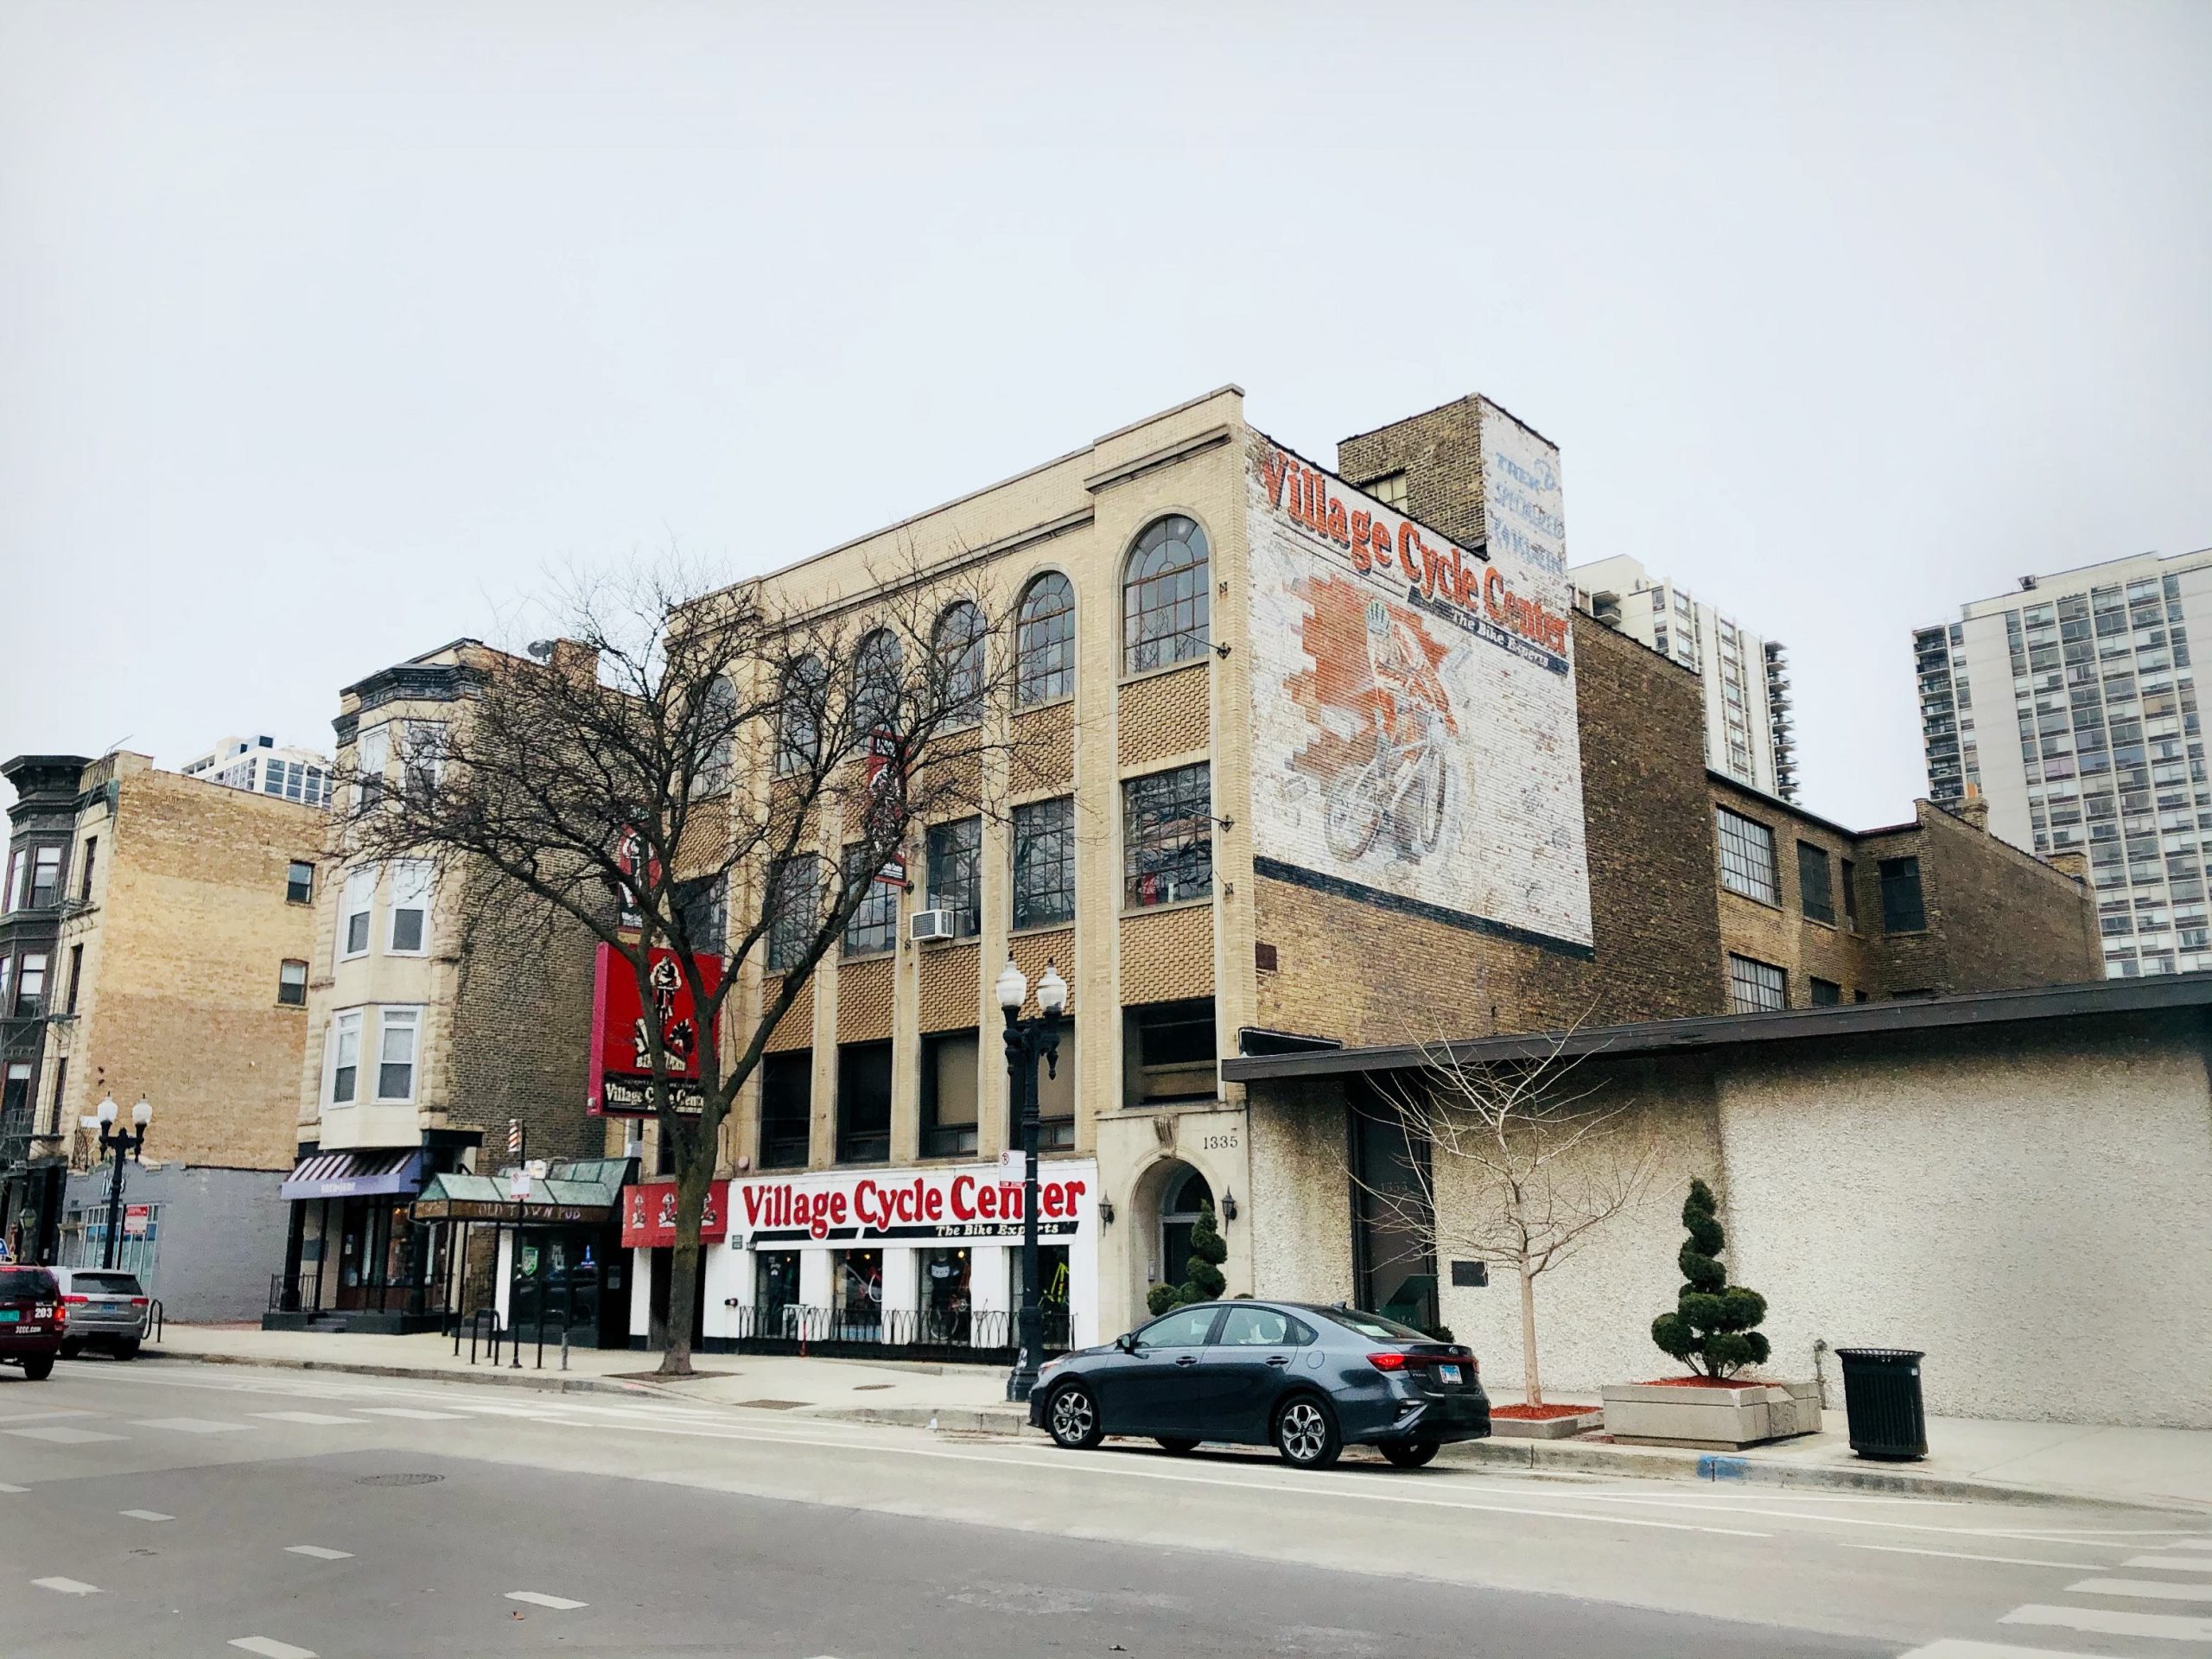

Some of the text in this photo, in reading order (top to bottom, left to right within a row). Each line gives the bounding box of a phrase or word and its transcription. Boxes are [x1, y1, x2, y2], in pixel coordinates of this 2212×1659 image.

[1262, 449, 1392, 576] Village
[1397, 521, 1479, 613] Cycle
[1484, 566, 1569, 658] Center
[1452, 608, 1549, 668] The Bike Experts
[605, 1083, 644, 1106] Village
[1203, 1135, 1238, 1150] 1335
[478, 1203, 503, 1217] OLD
[742, 1184, 847, 1239] Village
[855, 1177, 943, 1230] Cycle
[936, 1223, 1059, 1237] The Bike Exprts
[35, 1307, 53, 1319] 203
